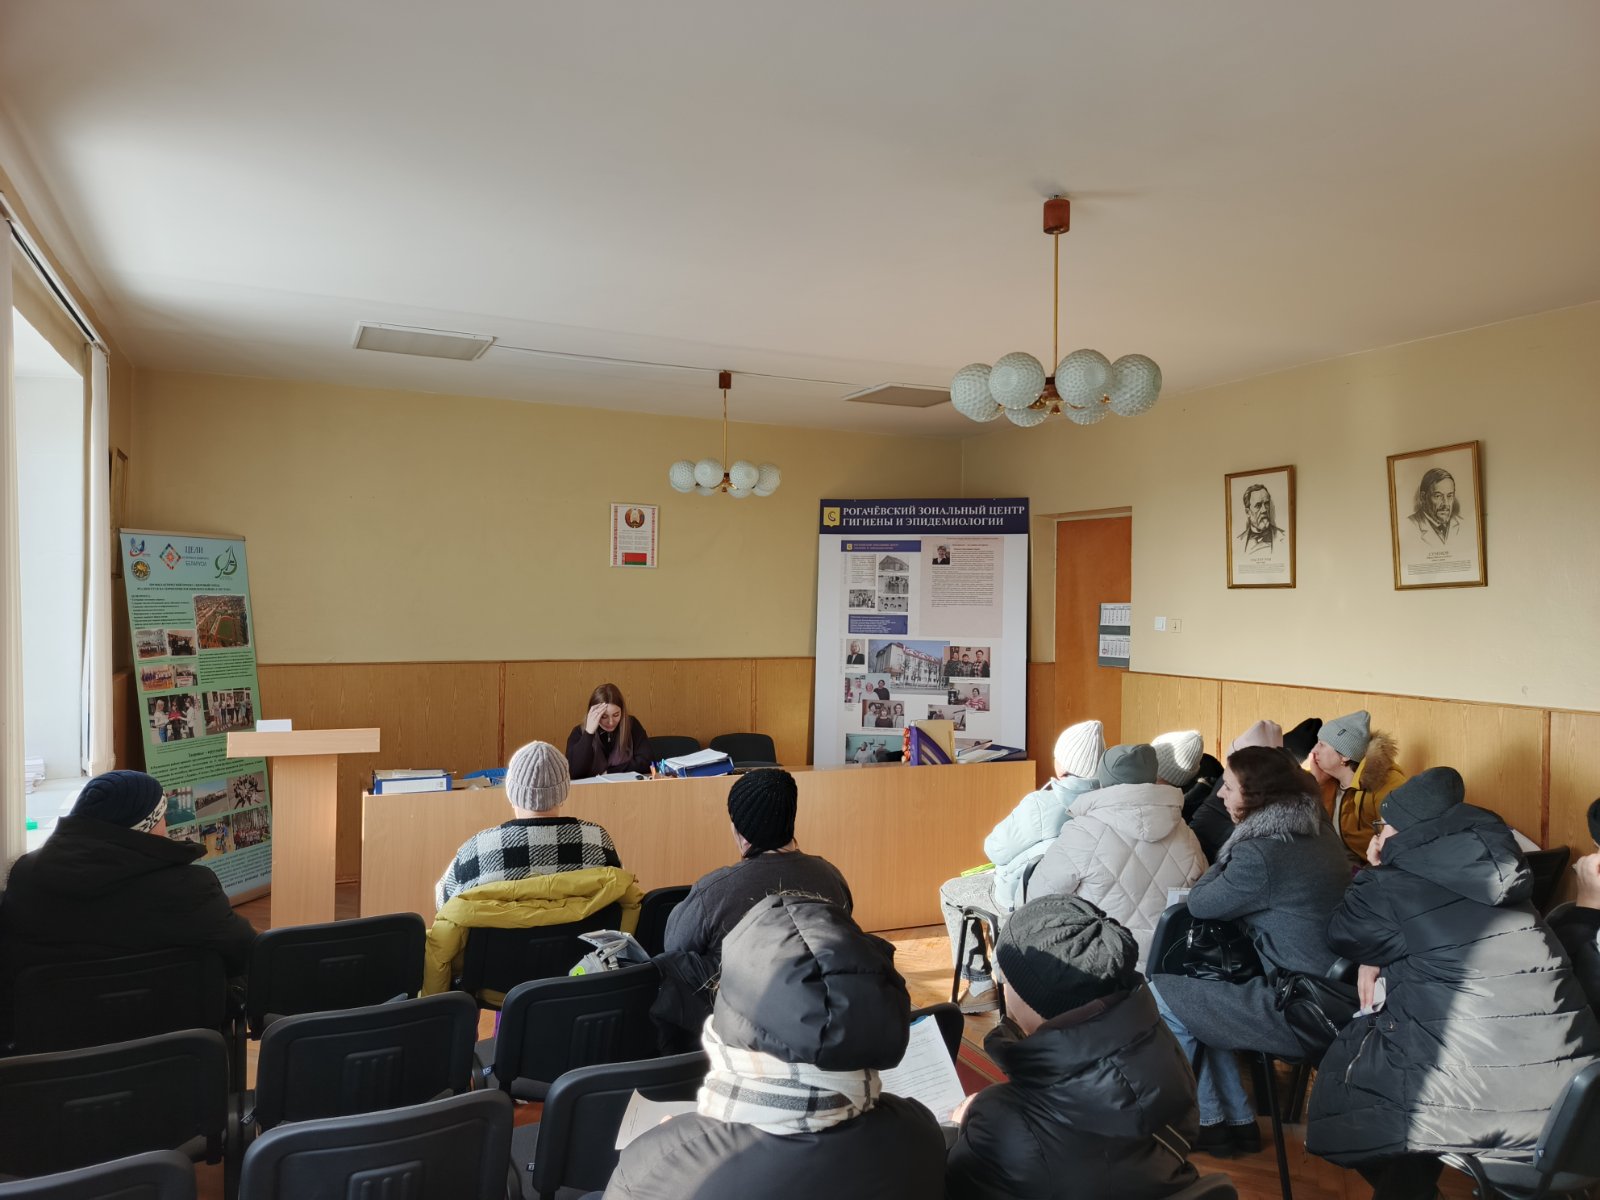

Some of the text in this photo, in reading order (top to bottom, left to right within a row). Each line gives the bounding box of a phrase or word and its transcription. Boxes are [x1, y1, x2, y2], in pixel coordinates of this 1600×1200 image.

[843, 505, 1025, 516] РОГАЧЁВСКИЙ ЗОНАЛЬНЫЙ ЦЕНТР
[842, 517, 1004, 527] ГИГИЕНЫ И ЭПИДЕМИОЛОГИИ
